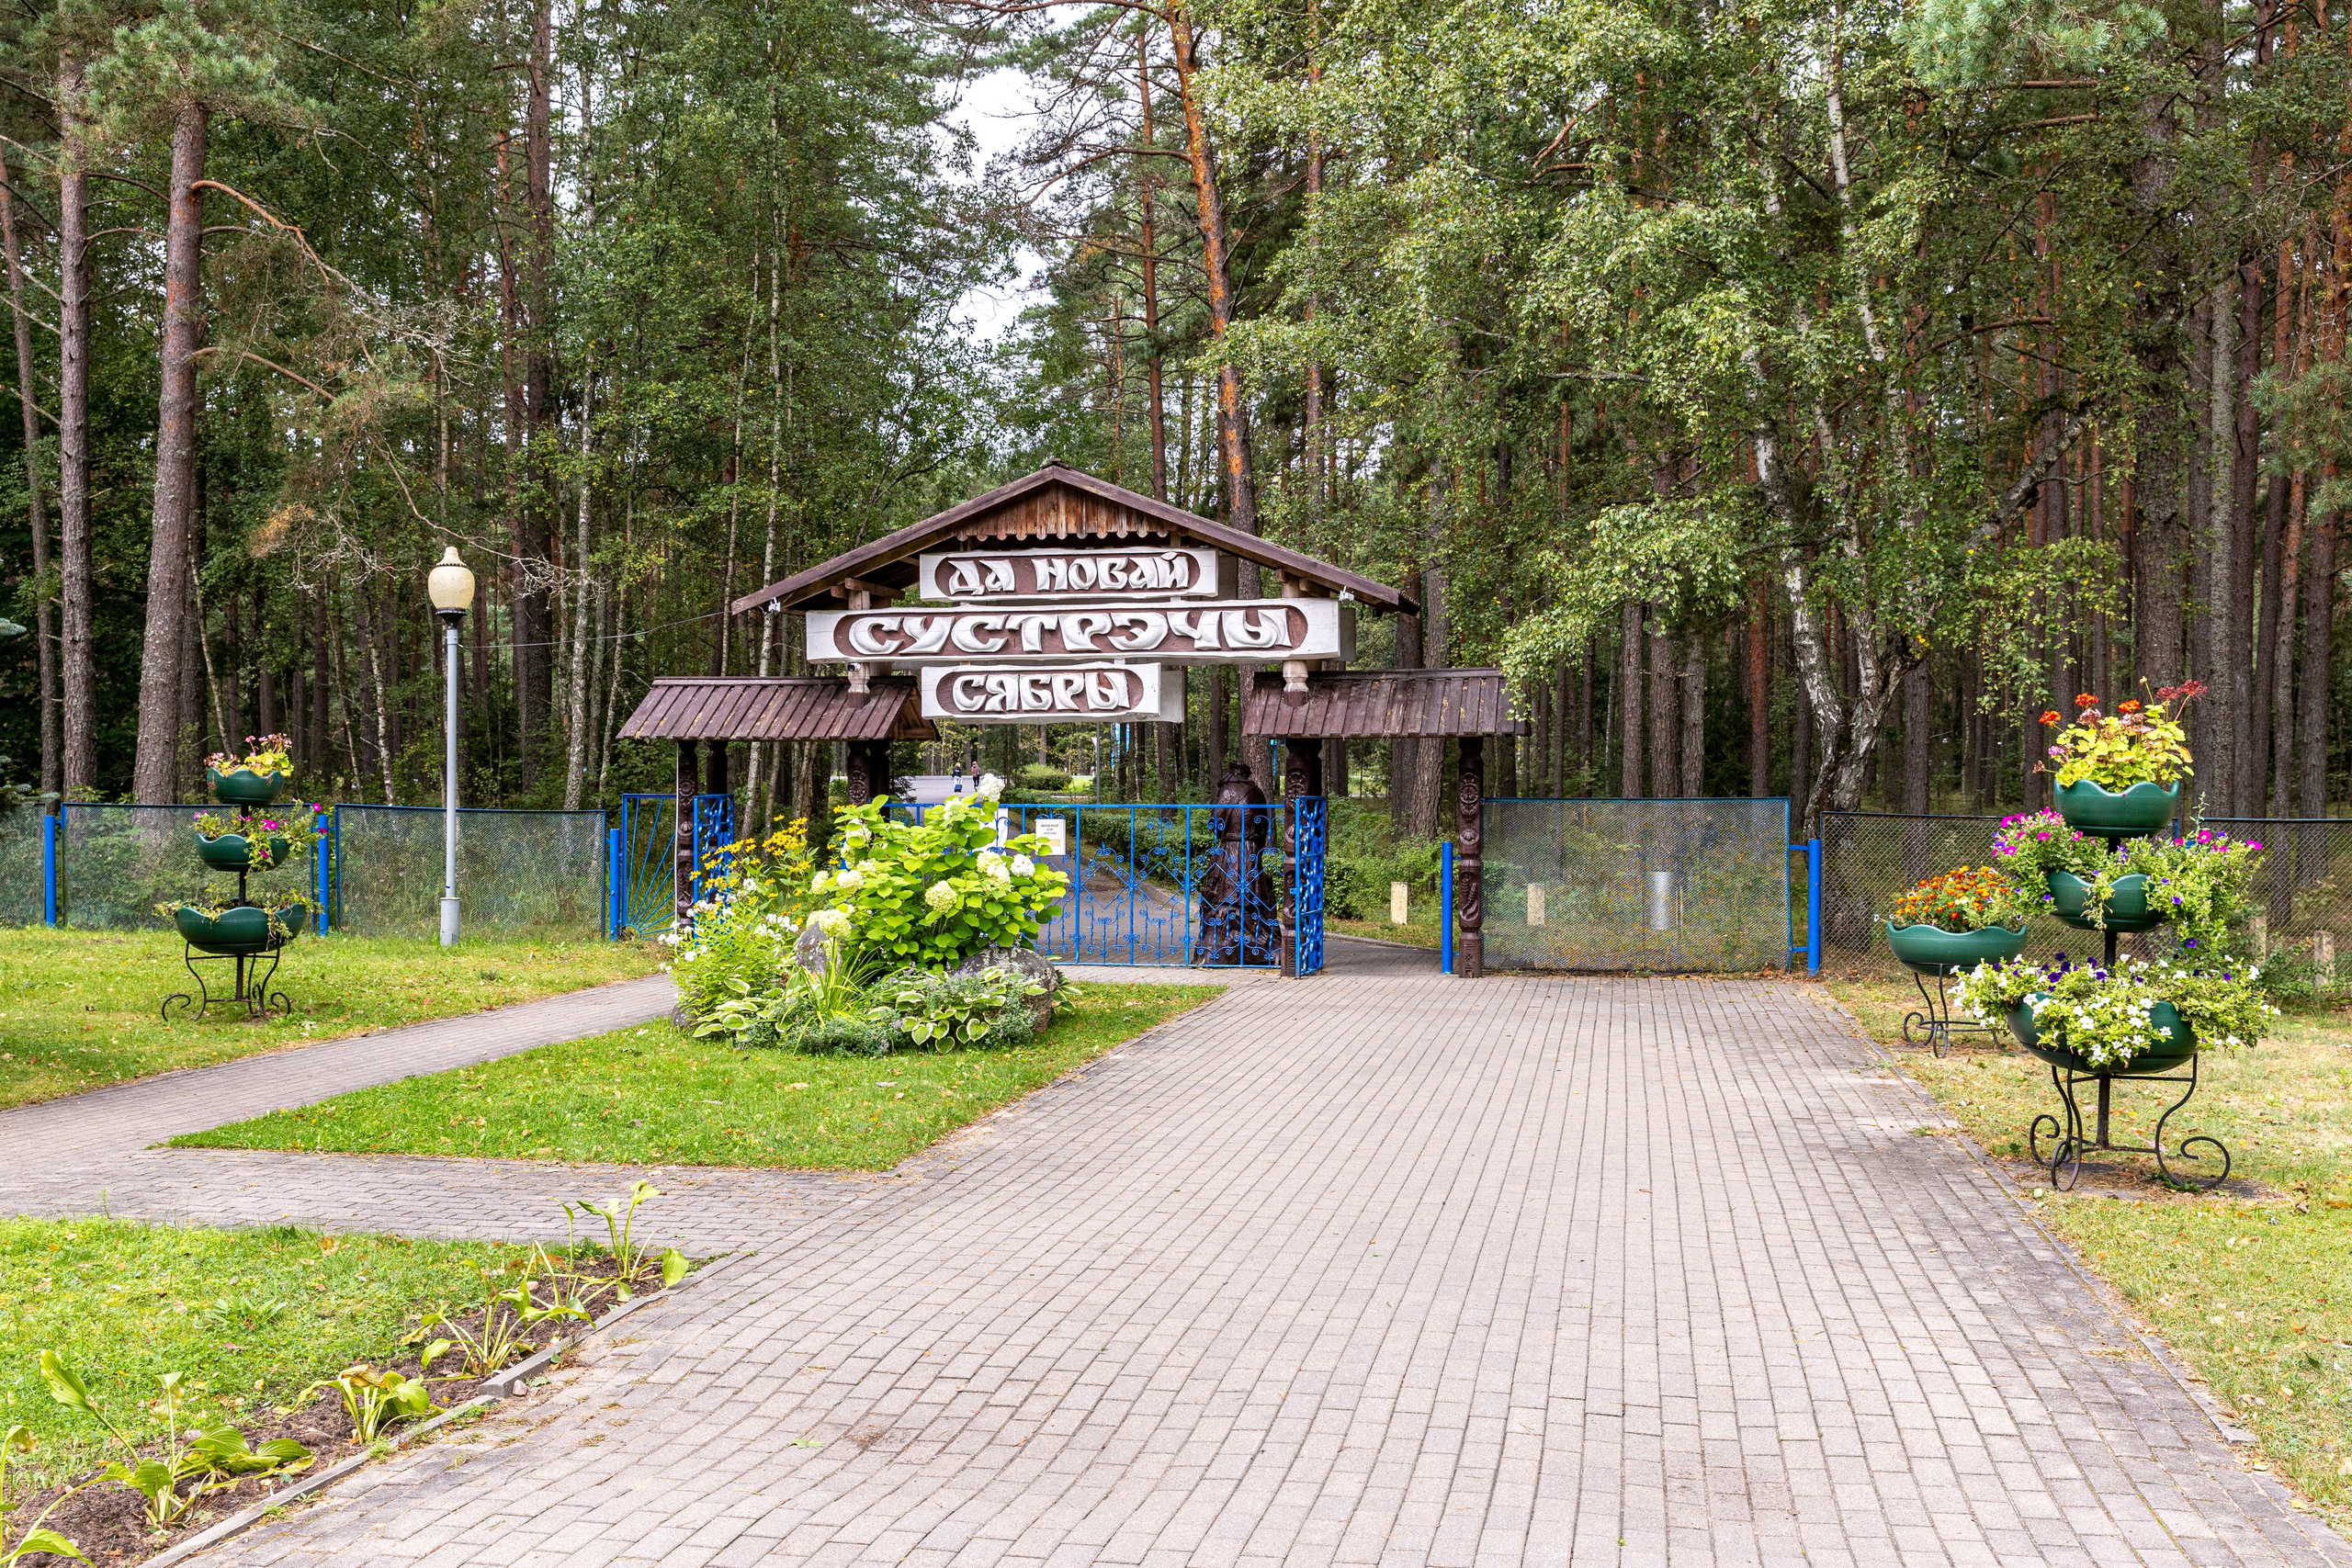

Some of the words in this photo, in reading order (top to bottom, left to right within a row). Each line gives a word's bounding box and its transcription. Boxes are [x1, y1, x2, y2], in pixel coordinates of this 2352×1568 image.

[947, 558, 1015, 595] ДА
[1031, 551, 1189, 591] НОВАЙ
[848, 609, 1294, 654] СУСТРЭЧЫ
[953, 671, 1130, 712] СЯБРЫ
